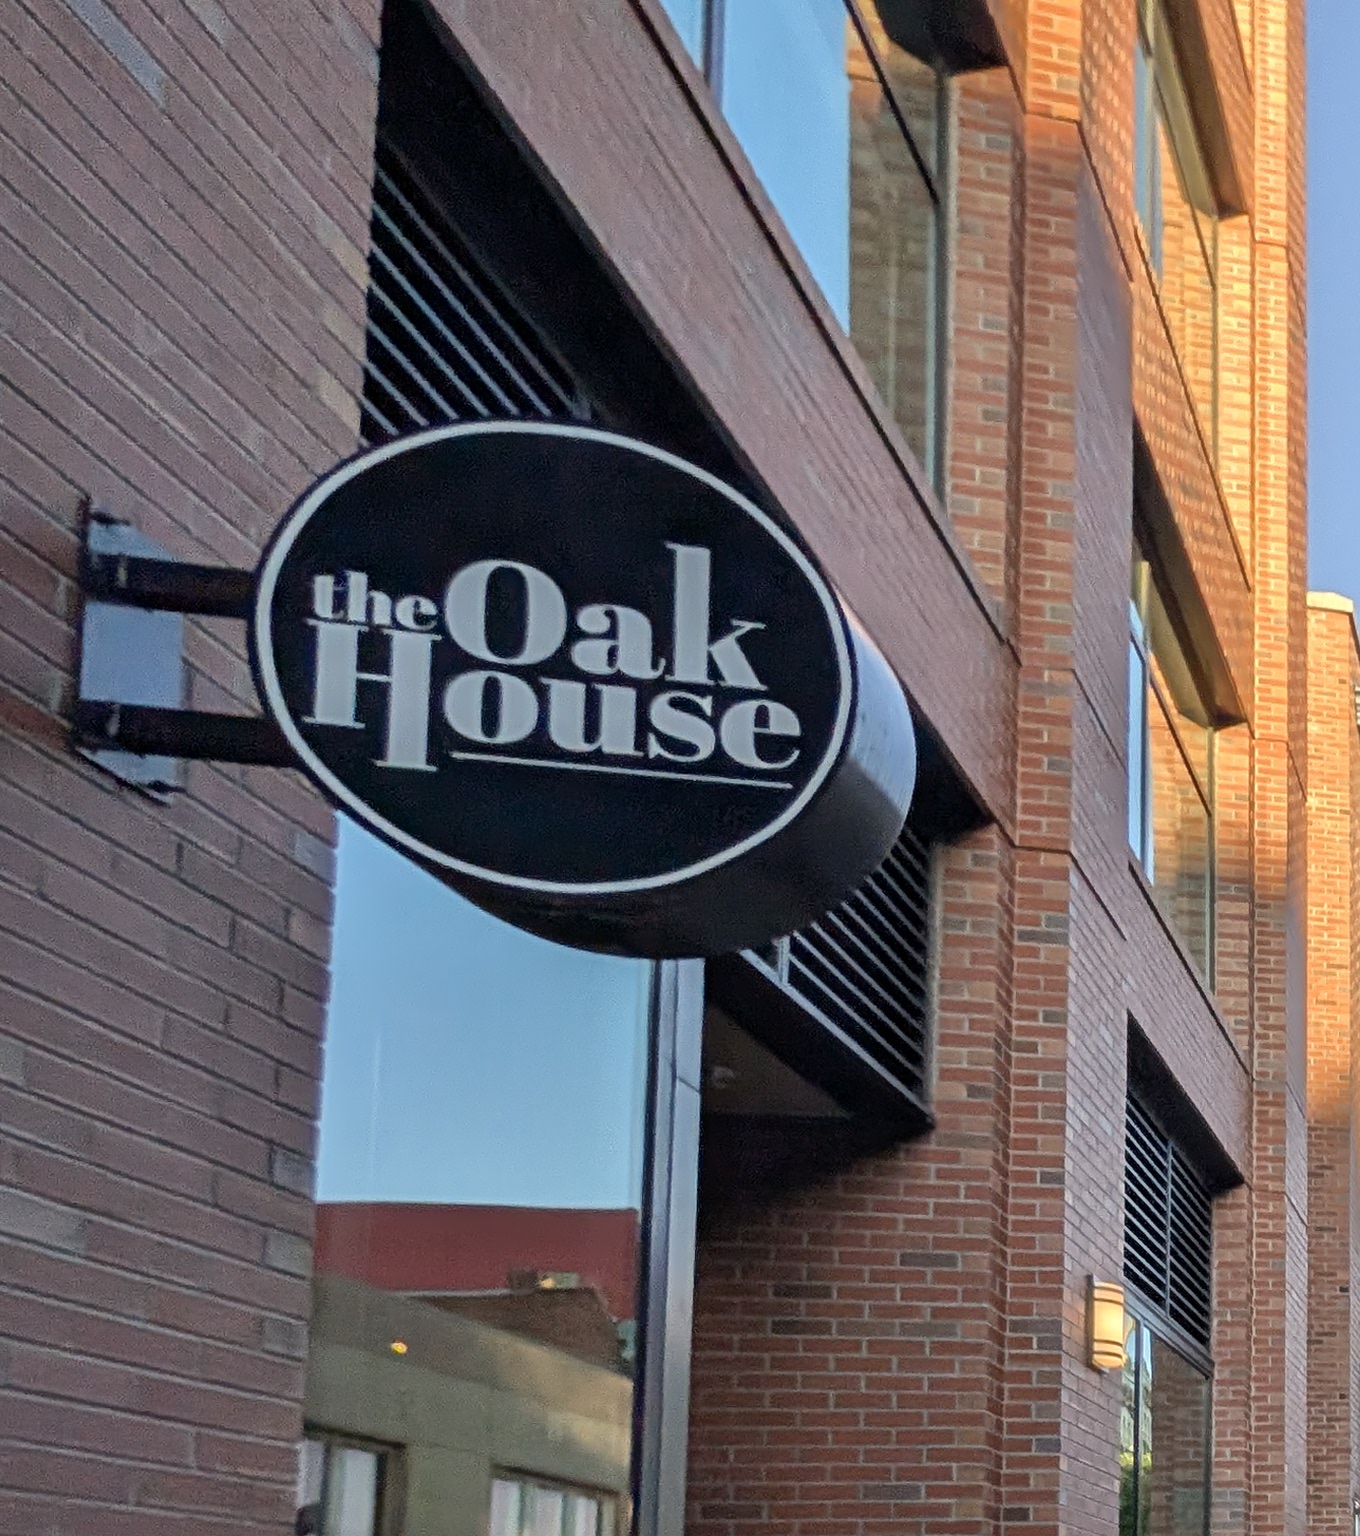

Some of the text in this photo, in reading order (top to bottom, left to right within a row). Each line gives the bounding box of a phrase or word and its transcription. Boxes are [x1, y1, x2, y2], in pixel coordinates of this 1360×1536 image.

[313, 541, 768, 691] the Oak
[303, 620, 802, 772] House
